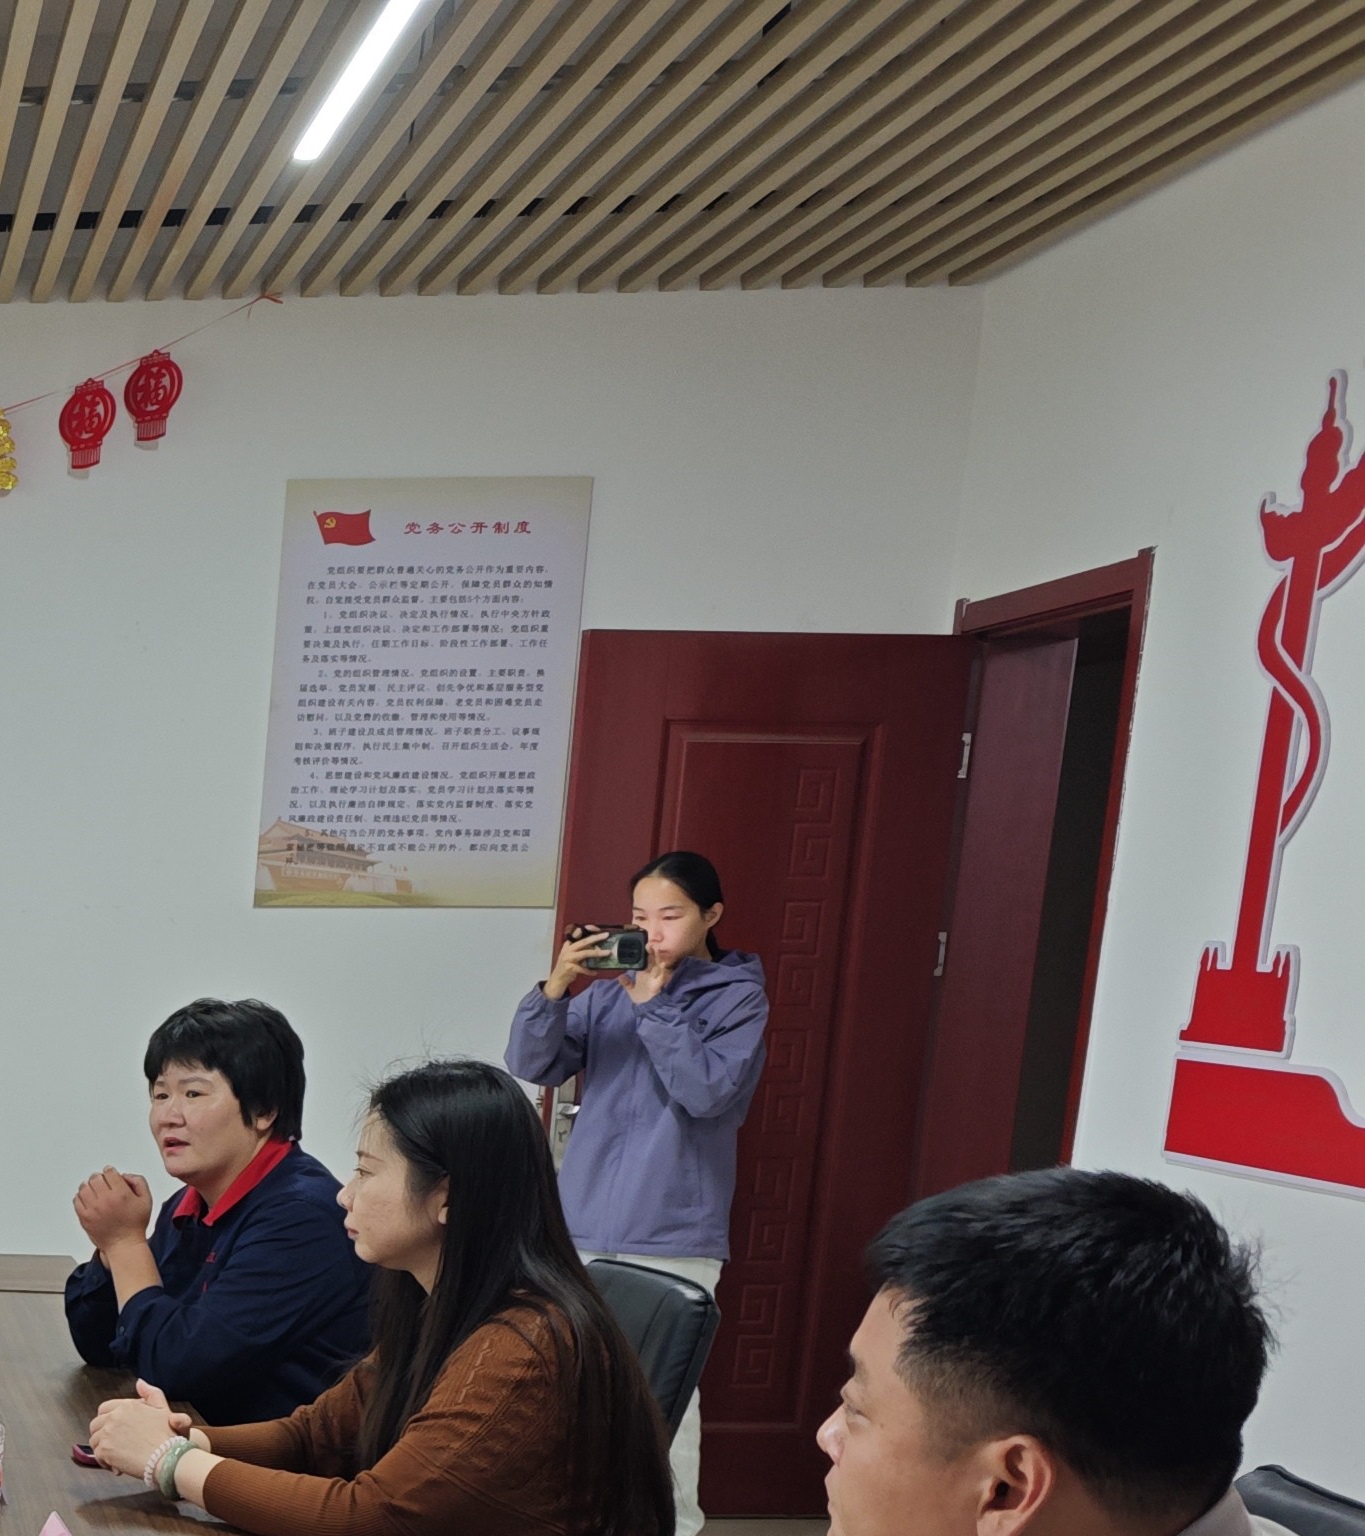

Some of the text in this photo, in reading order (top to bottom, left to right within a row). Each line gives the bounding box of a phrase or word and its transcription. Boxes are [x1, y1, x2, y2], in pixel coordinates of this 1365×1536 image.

[402, 520, 533, 535] 党务公开制度
